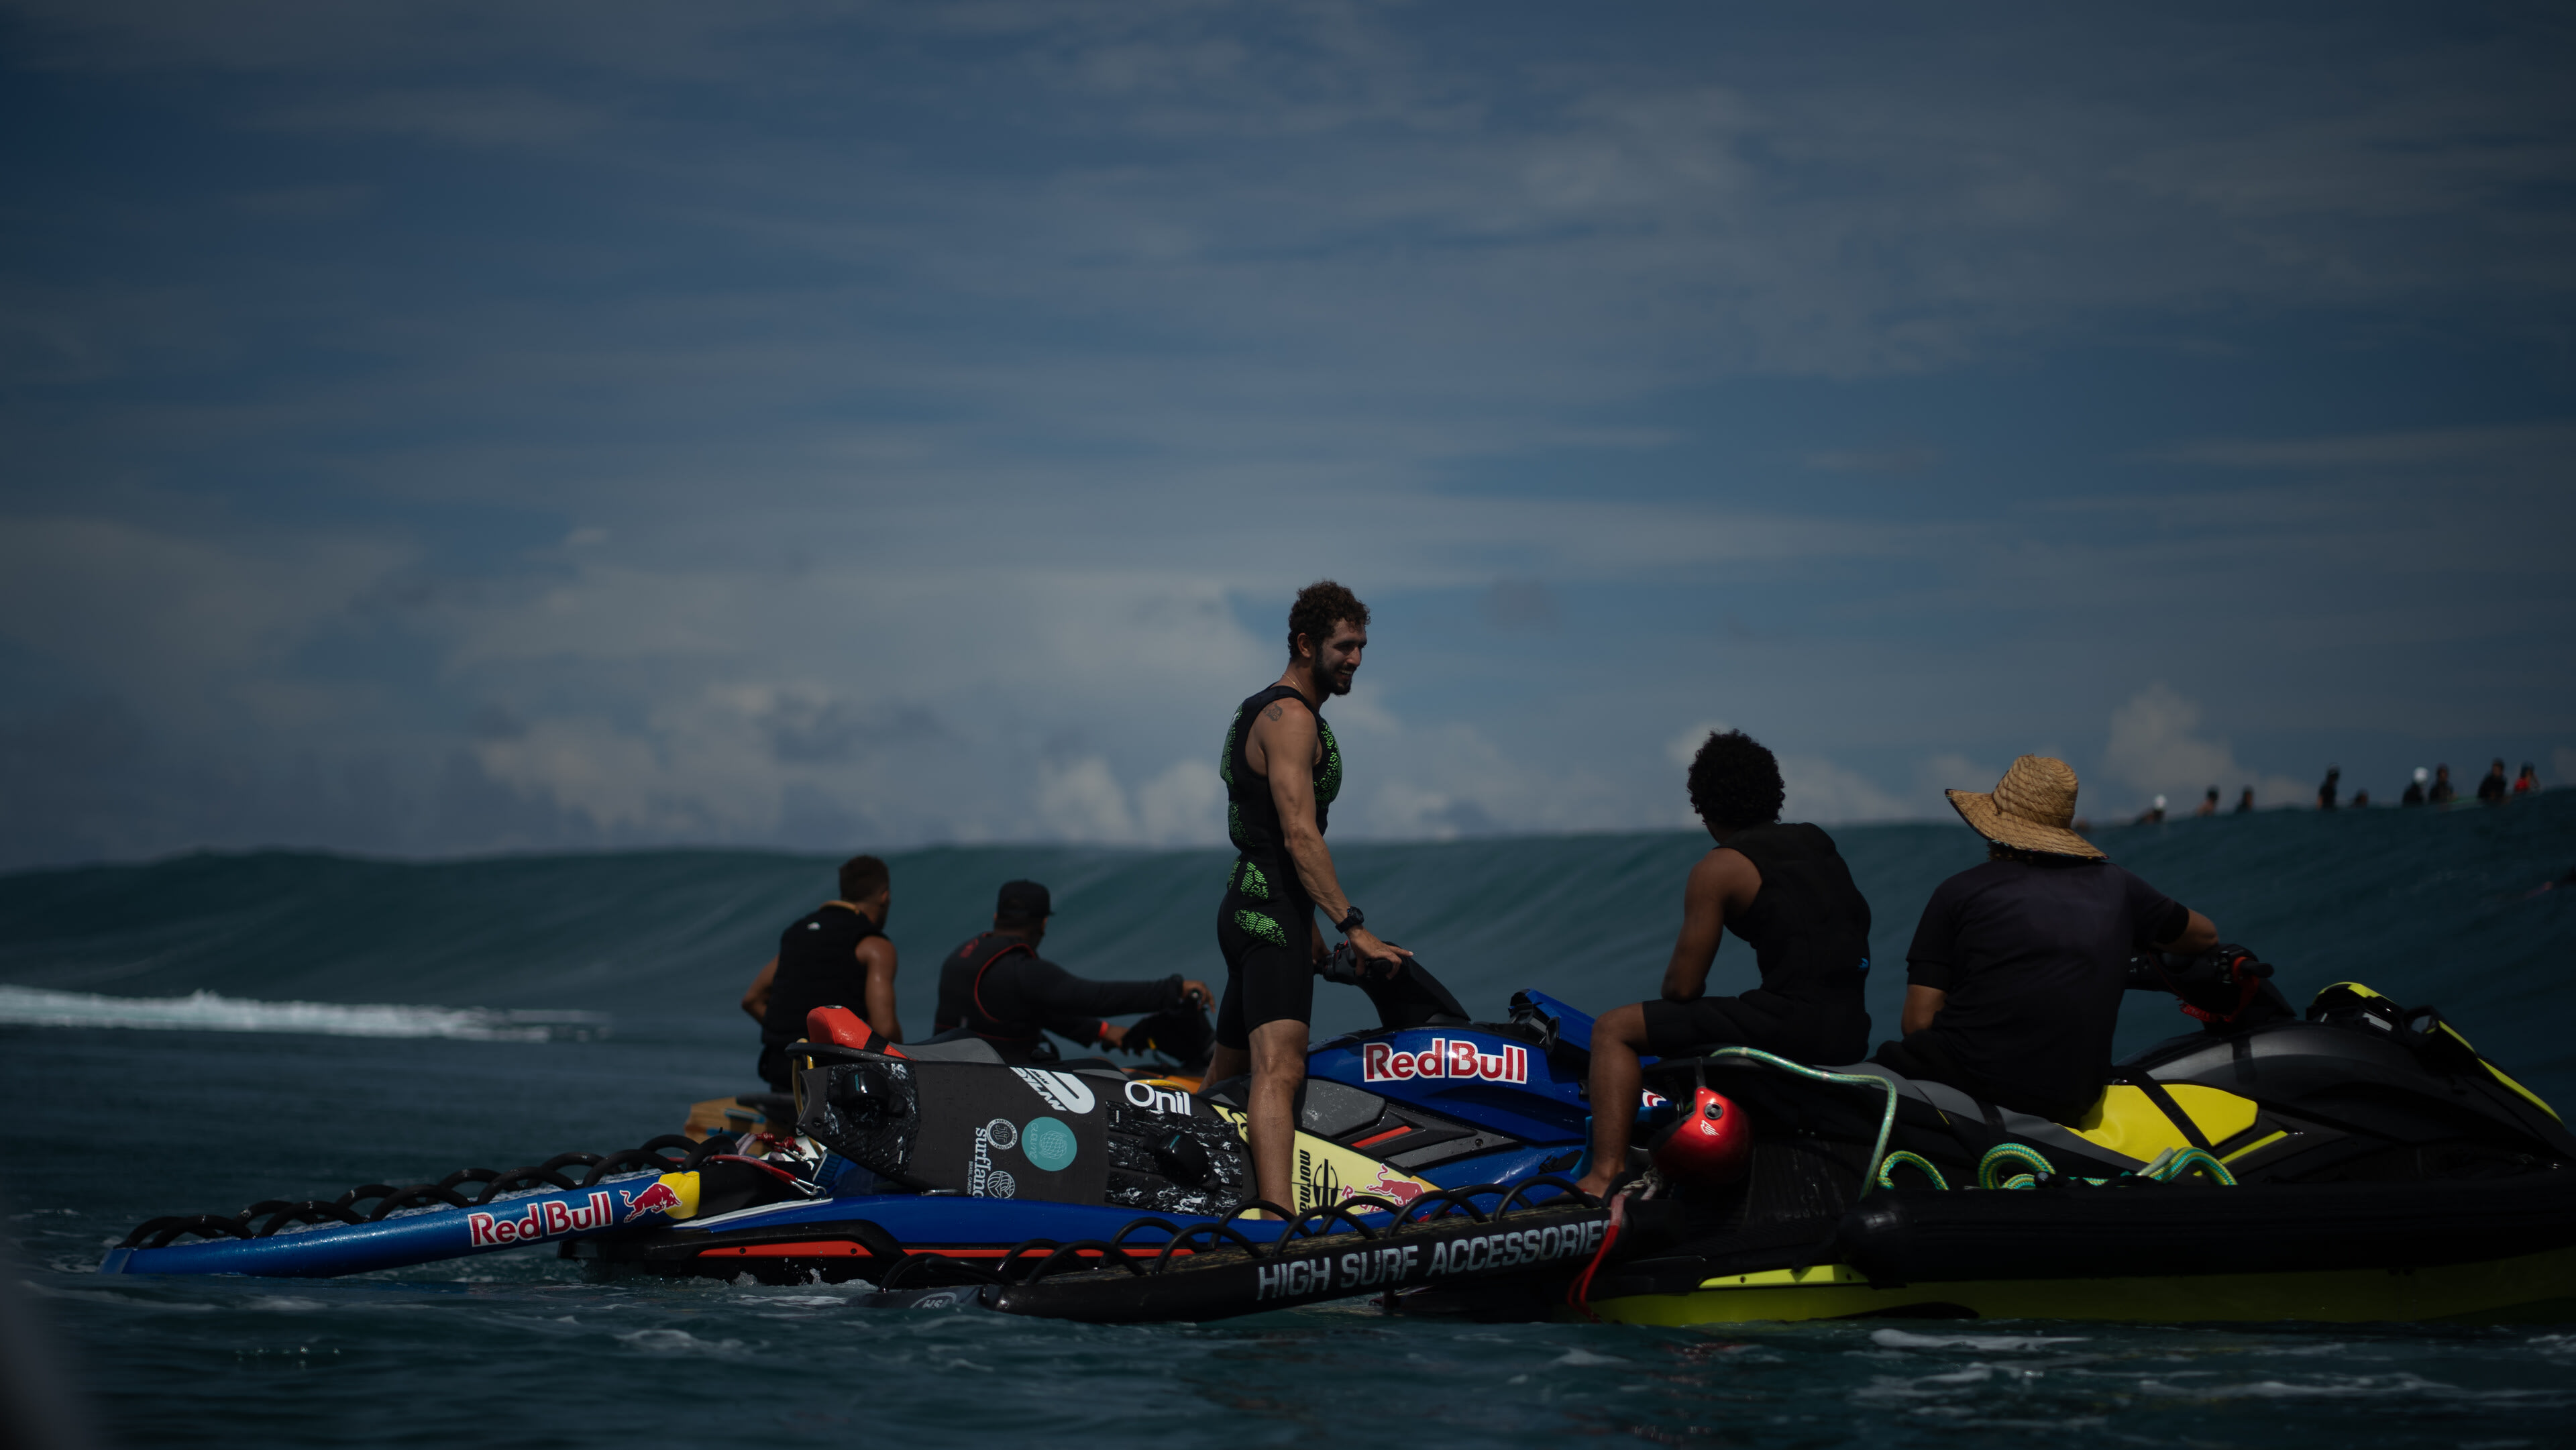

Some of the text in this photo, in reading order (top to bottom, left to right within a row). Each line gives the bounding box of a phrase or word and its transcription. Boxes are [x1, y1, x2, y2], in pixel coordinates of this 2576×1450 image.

[1364, 1038, 1527, 1084] Red Bull
[1124, 1081, 1192, 1117] Onil
[468, 1192, 612, 1247] Red Bull
[1256, 1257, 1332, 1300] HIGH
[1340, 1245, 1419, 1288] SURF
